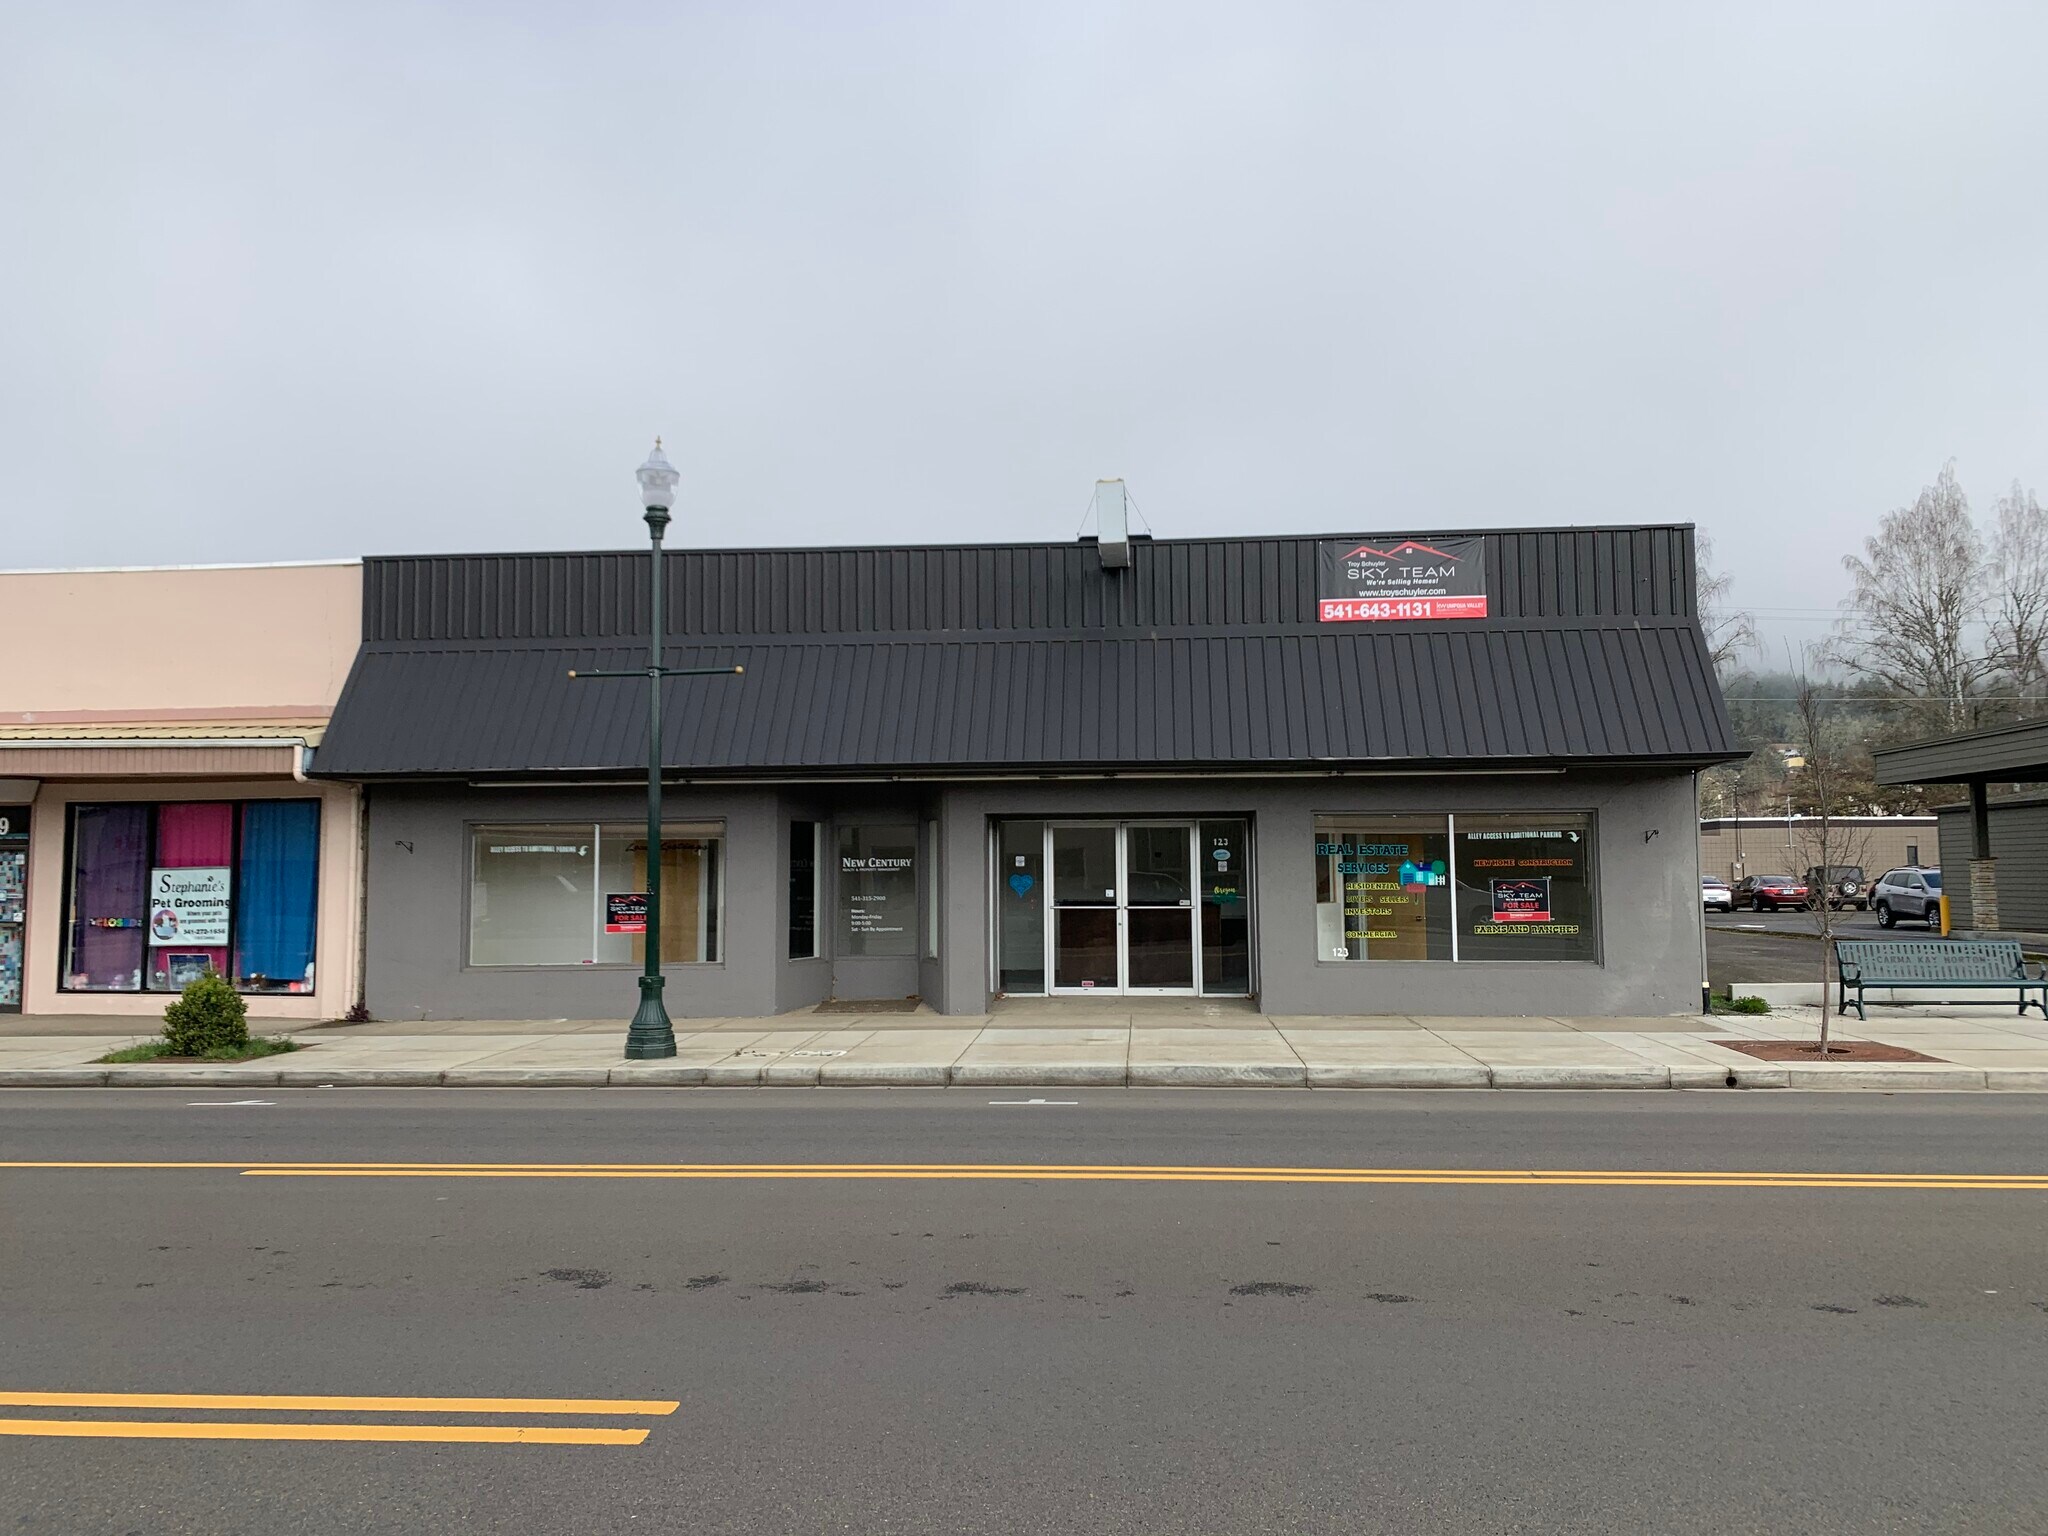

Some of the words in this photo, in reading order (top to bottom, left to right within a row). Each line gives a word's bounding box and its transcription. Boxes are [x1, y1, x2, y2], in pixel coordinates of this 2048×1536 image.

[1347, 568, 1389, 580] SKY
[1399, 566, 1455, 578] TEAM
[1359, 588, 1447, 597] www.troyschuyler.com
[1324, 602, 1432, 619] 541-643-1131
[0, 817, 9, 835] 9
[1213, 838, 1229, 846] 123
[1316, 843, 1353, 856] REAL
[1358, 844, 1409, 857] ESTATE
[842, 857, 865, 867] NEW
[868, 857, 912, 867] CENTURY
[1473, 859, 1491, 867] NEW
[1492, 859, 1515, 867] HOME
[1518, 859, 1573, 867] CONSTRUCTION
[1337, 862, 1390, 874] SERVICES
[160, 874, 225, 895] Stephanie's
[1345, 882, 1400, 890] RESIDENTIAL
[152, 899, 171, 908] Pet
[175, 897, 231, 909] Grooming
[1346, 895, 1373, 903] BUYERS
[1380, 895, 1409, 904] SELLERS
[1344, 907, 1392, 916] INVESTORS
[1345, 930, 1398, 938] COMMERCIAL
[1474, 924, 1506, 934] FARMS
[1507, 924, 1530, 934] AND
[1531, 924, 1579, 935] RANCHES
[1332, 947, 1349, 957] 123
